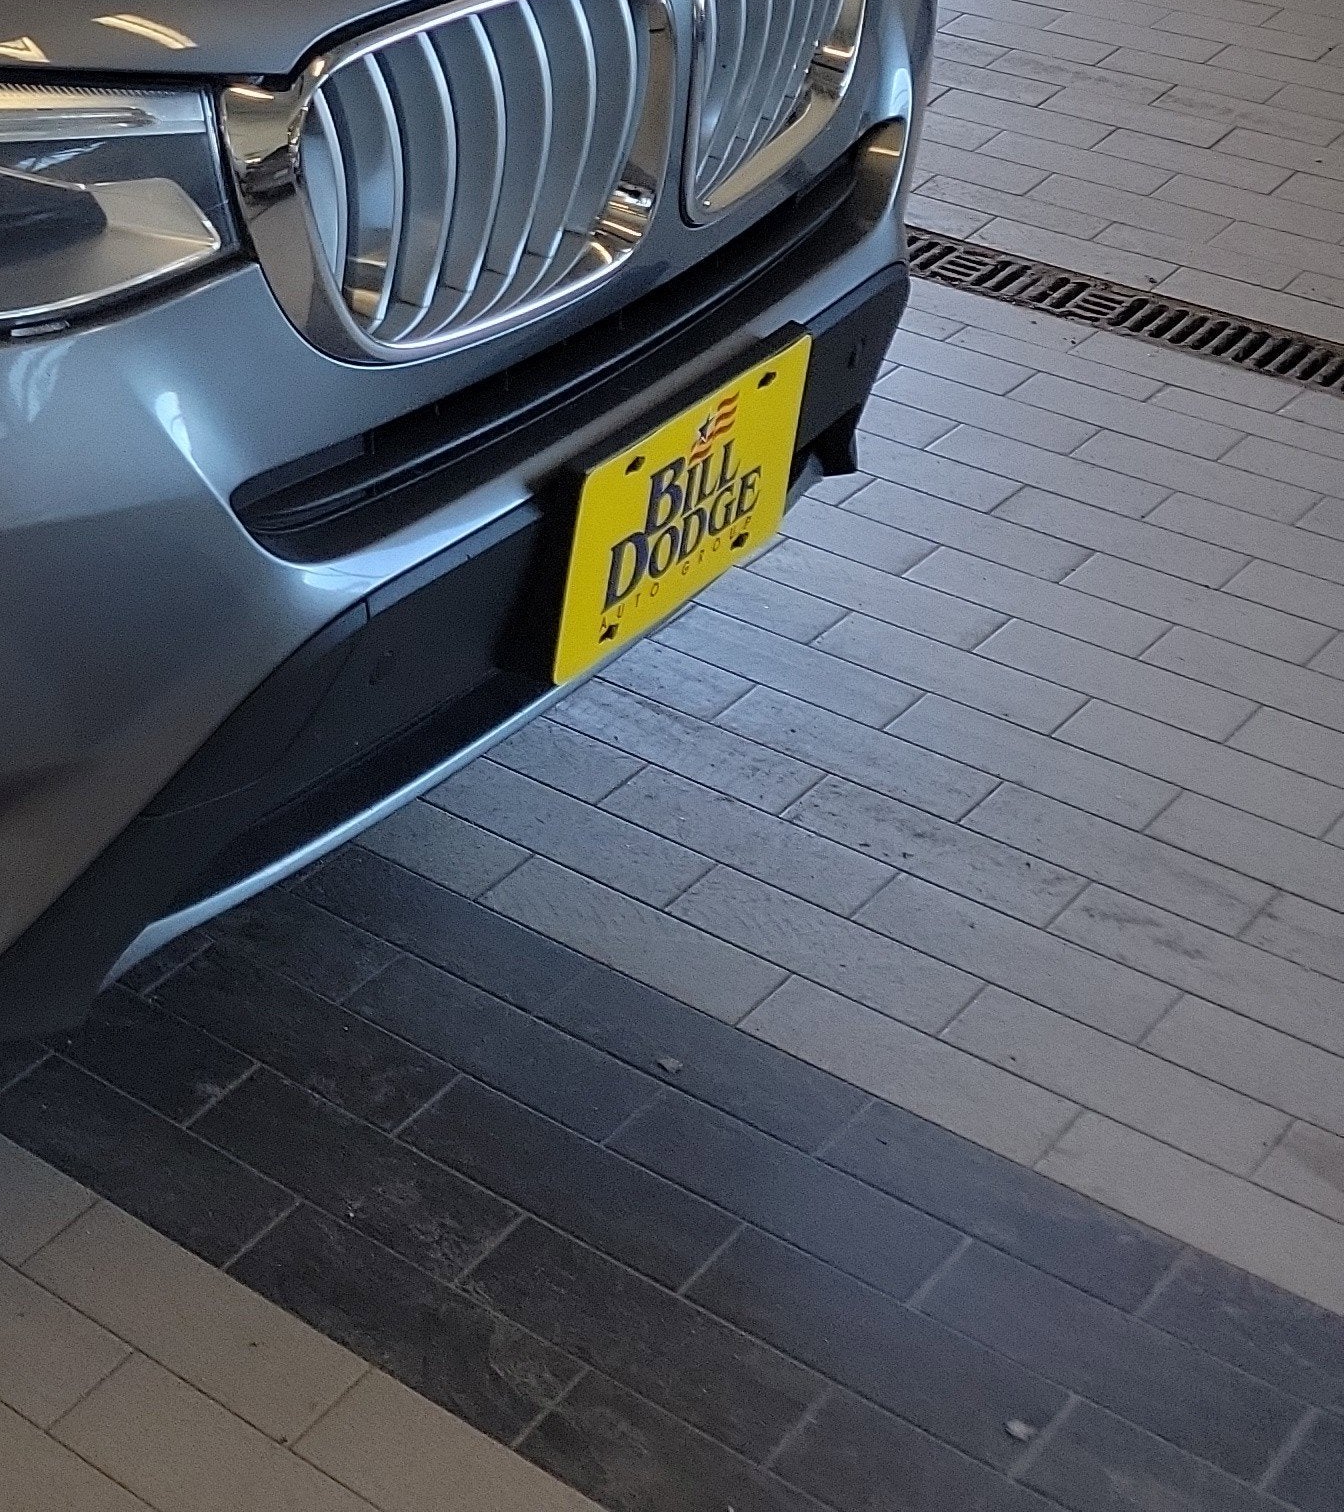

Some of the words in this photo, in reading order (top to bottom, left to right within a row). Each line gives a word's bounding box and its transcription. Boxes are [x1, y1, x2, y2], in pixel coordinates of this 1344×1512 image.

[643, 439, 741, 536] BILL
[601, 465, 762, 615] DODGE
[598, 581, 661, 634] AUTO
